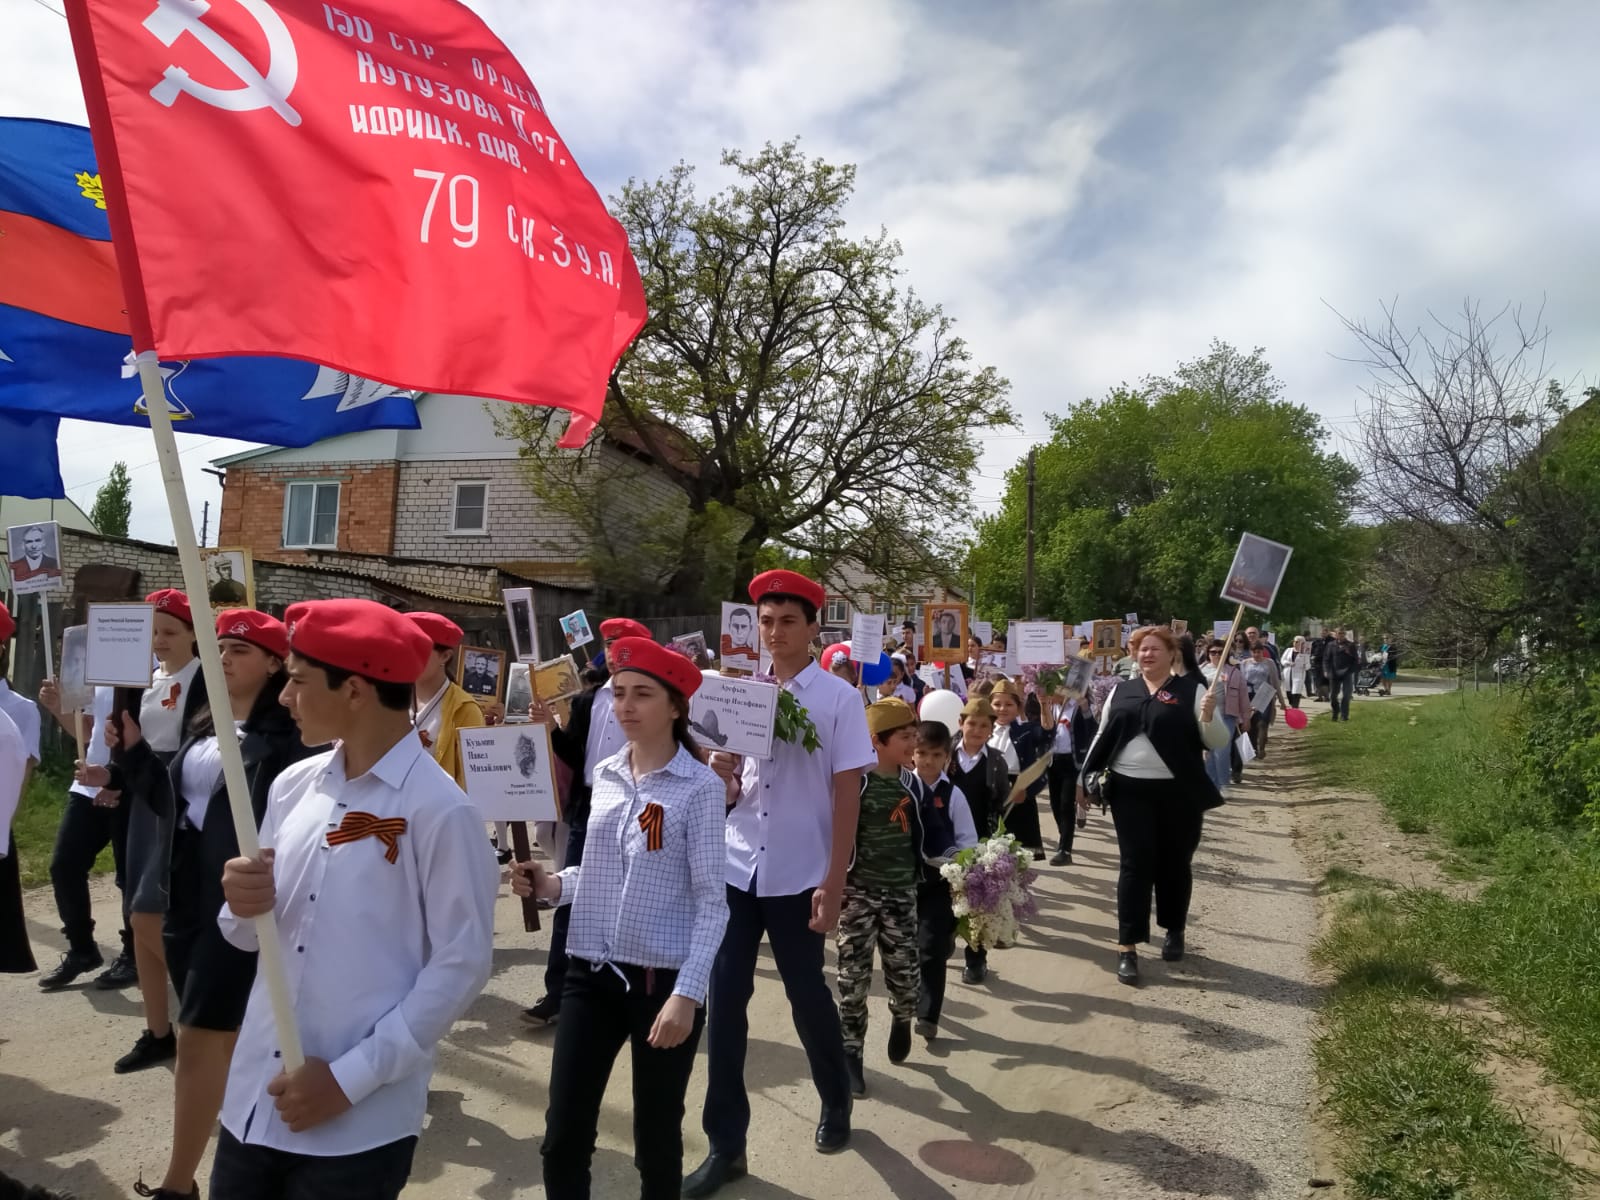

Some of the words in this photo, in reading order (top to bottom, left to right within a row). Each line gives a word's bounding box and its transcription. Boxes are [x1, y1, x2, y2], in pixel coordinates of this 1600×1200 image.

[322, 3, 374, 44] 150
[349, 104, 471, 149] ИДРИЦК.
[477, 131, 528, 174] ДИВ.
[413, 168, 480, 248] 79
[699, 692, 731, 704] Александр
[467, 751, 489, 760] Павел
[469, 763, 512, 772] Михайлович
